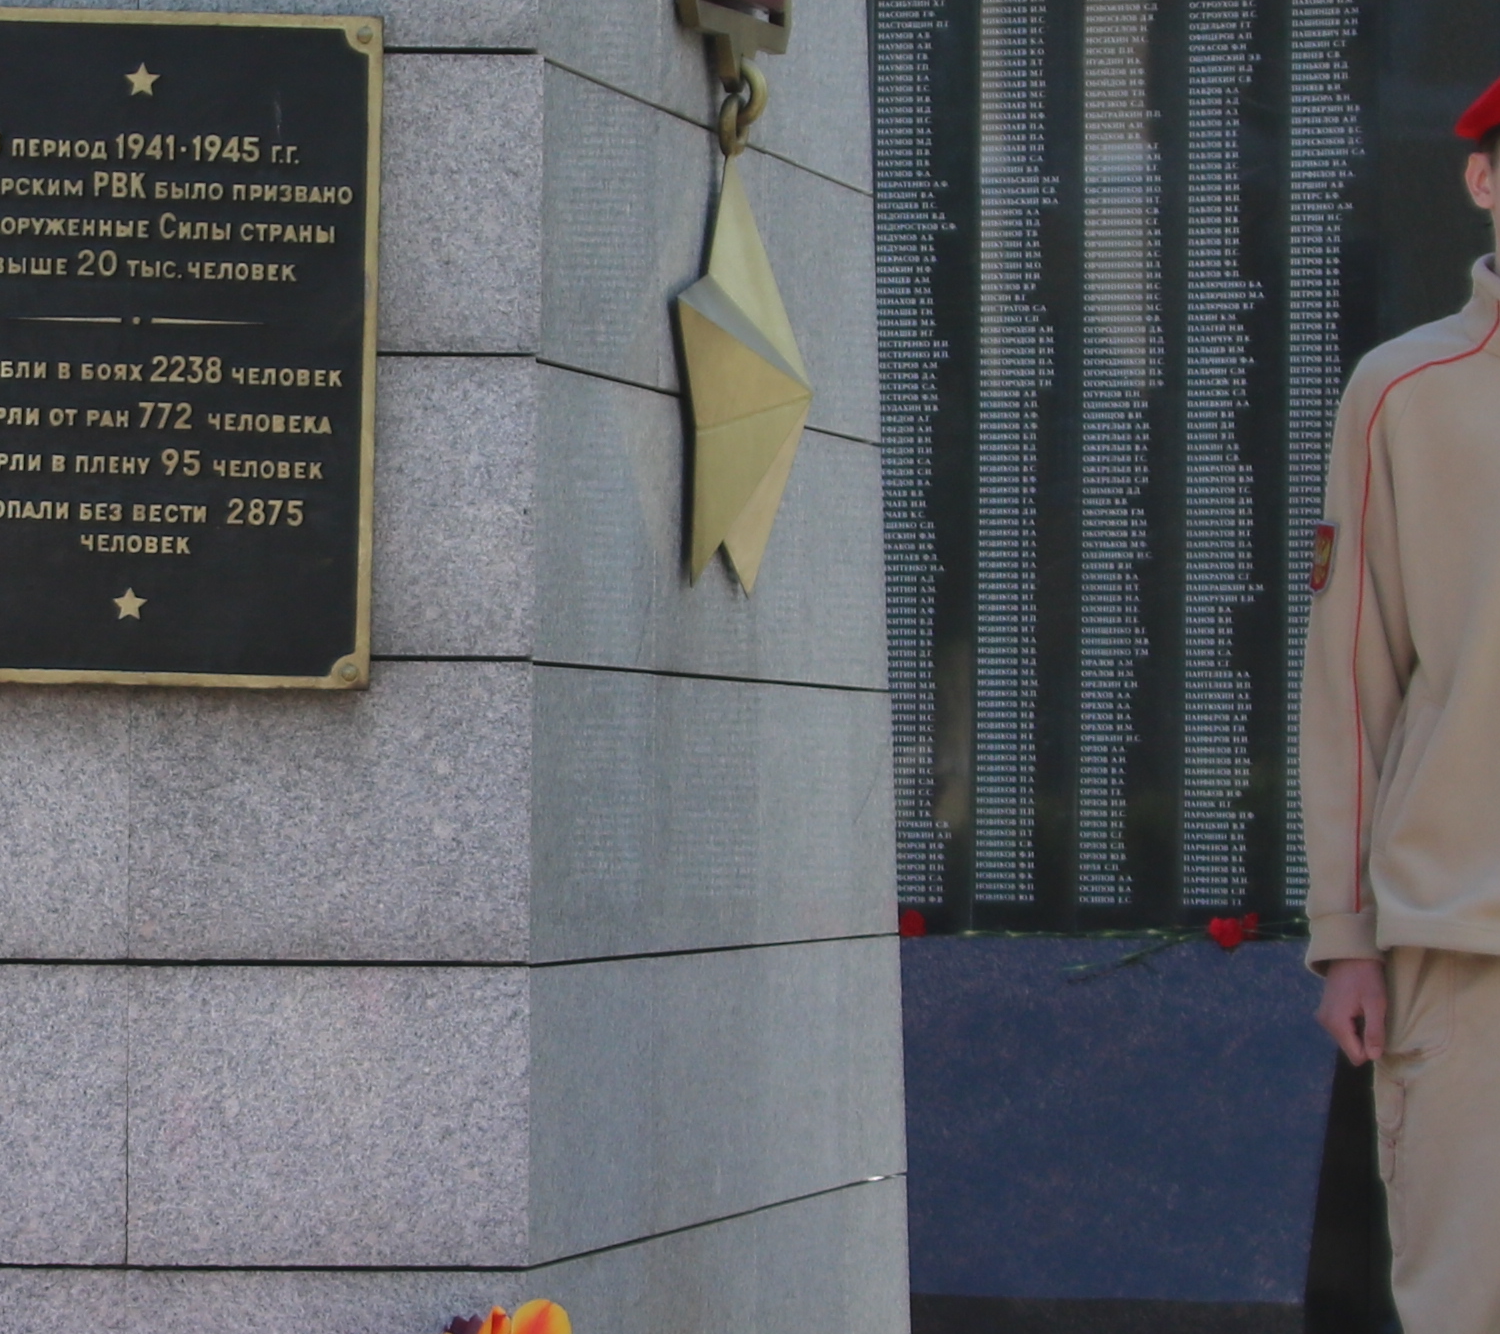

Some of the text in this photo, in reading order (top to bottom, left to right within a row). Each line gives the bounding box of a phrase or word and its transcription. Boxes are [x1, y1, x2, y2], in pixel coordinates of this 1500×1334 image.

[93, 170, 146, 199] РВК
[77, 249, 117, 277] 20
[149, 355, 222, 384] 2238
[138, 401, 192, 430] 772
[161, 448, 201, 477] 95
[226, 497, 304, 527] 2875
